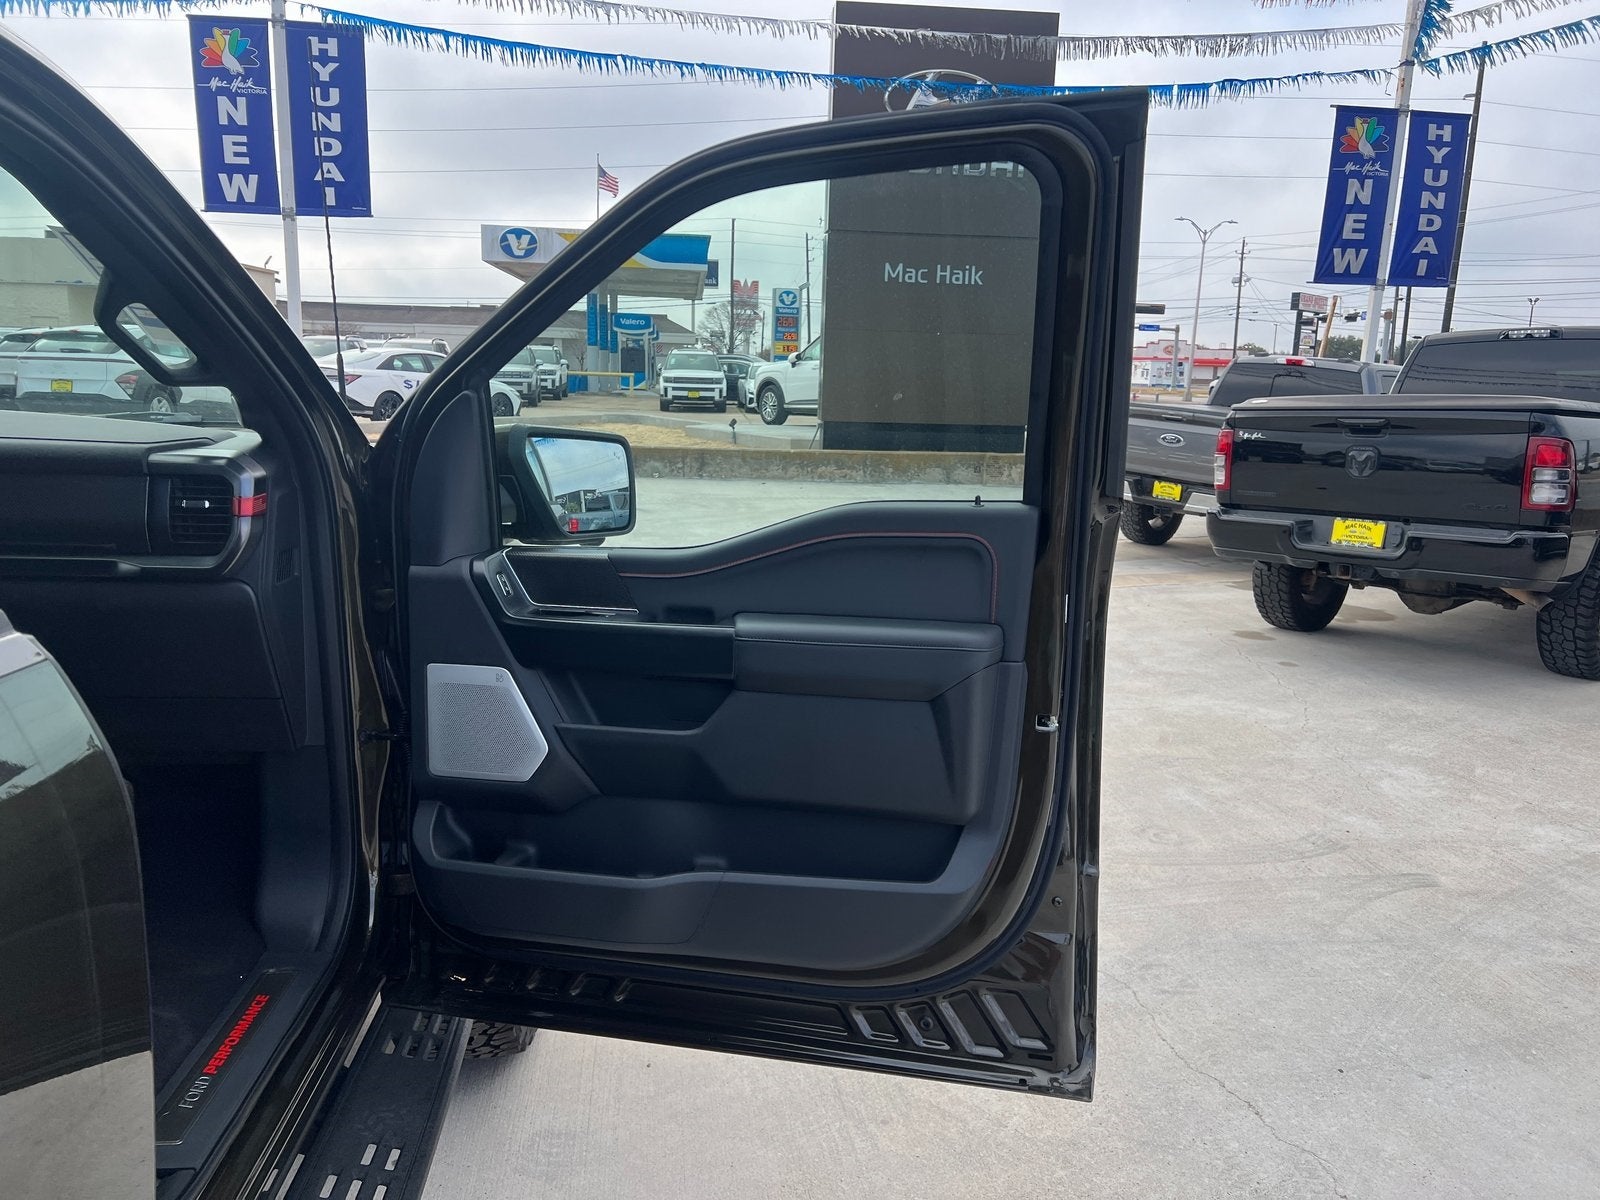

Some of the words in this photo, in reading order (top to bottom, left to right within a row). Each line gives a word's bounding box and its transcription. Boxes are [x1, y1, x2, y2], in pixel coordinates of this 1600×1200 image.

[236, 87, 268, 95] VICTORIA
[307, 36, 346, 206] HYUNDAI
[216, 95, 259, 203] NEW
[1411, 123, 1453, 277] HYUNDAI
[884, 262, 928, 284] Mac
[936, 264, 984, 286] Haik
[1332, 178, 1374, 274] NEW
[619, 317, 646, 326] Valero
[178, 1075, 211, 1109] FORD
[203, 993, 271, 1076] PERFORMANCE
